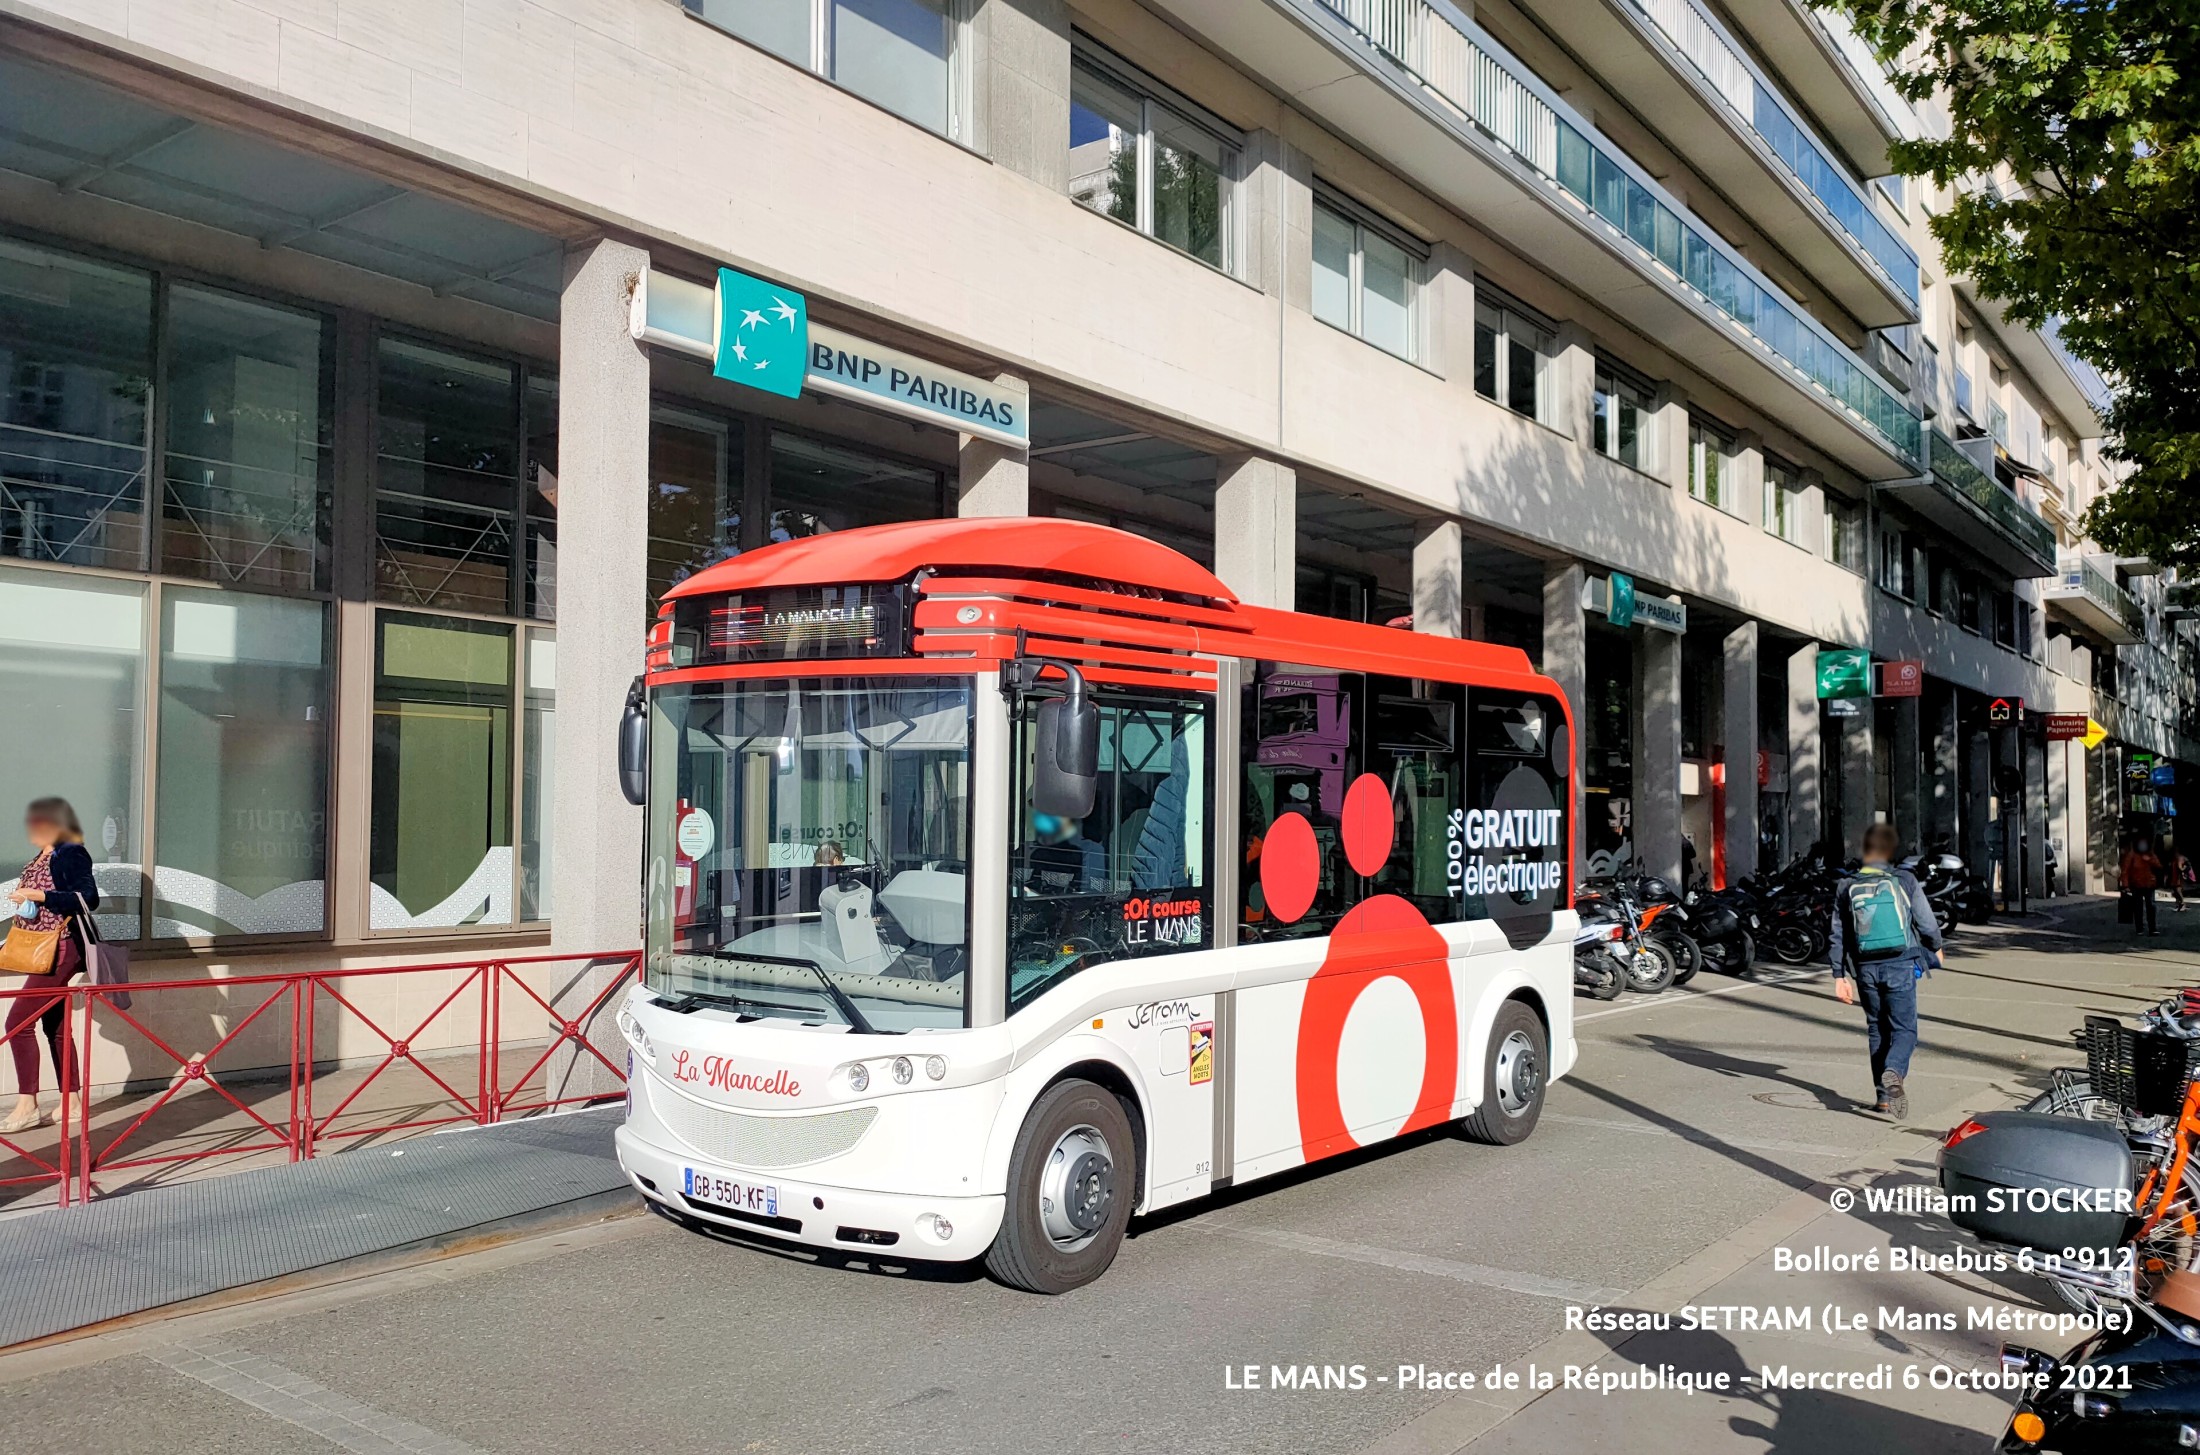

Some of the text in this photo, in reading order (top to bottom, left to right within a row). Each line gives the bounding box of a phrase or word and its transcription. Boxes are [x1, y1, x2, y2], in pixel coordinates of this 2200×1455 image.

[812, 342, 1015, 427] BNP PARIBAS
[1634, 600, 1681, 624] NP PARIBAS
[2046, 726, 2086, 735] Papeterie
[2051, 719, 2085, 727] Librairie
[1465, 808, 1561, 849] GRATUIT
[1447, 808, 1463, 898] 100%
[1464, 853, 1561, 900] électrique
[1152, 899, 1201, 918] course
[1127, 916, 1201, 944] LE MANS
[671, 1050, 802, 1098] La Mancelle
[1193, 1063, 1210, 1073] ANGLES
[1195, 1160, 1210, 1175] 912
[694, 1174, 765, 1210] GB-550-KF
[767, 1201, 777, 1213] 72
